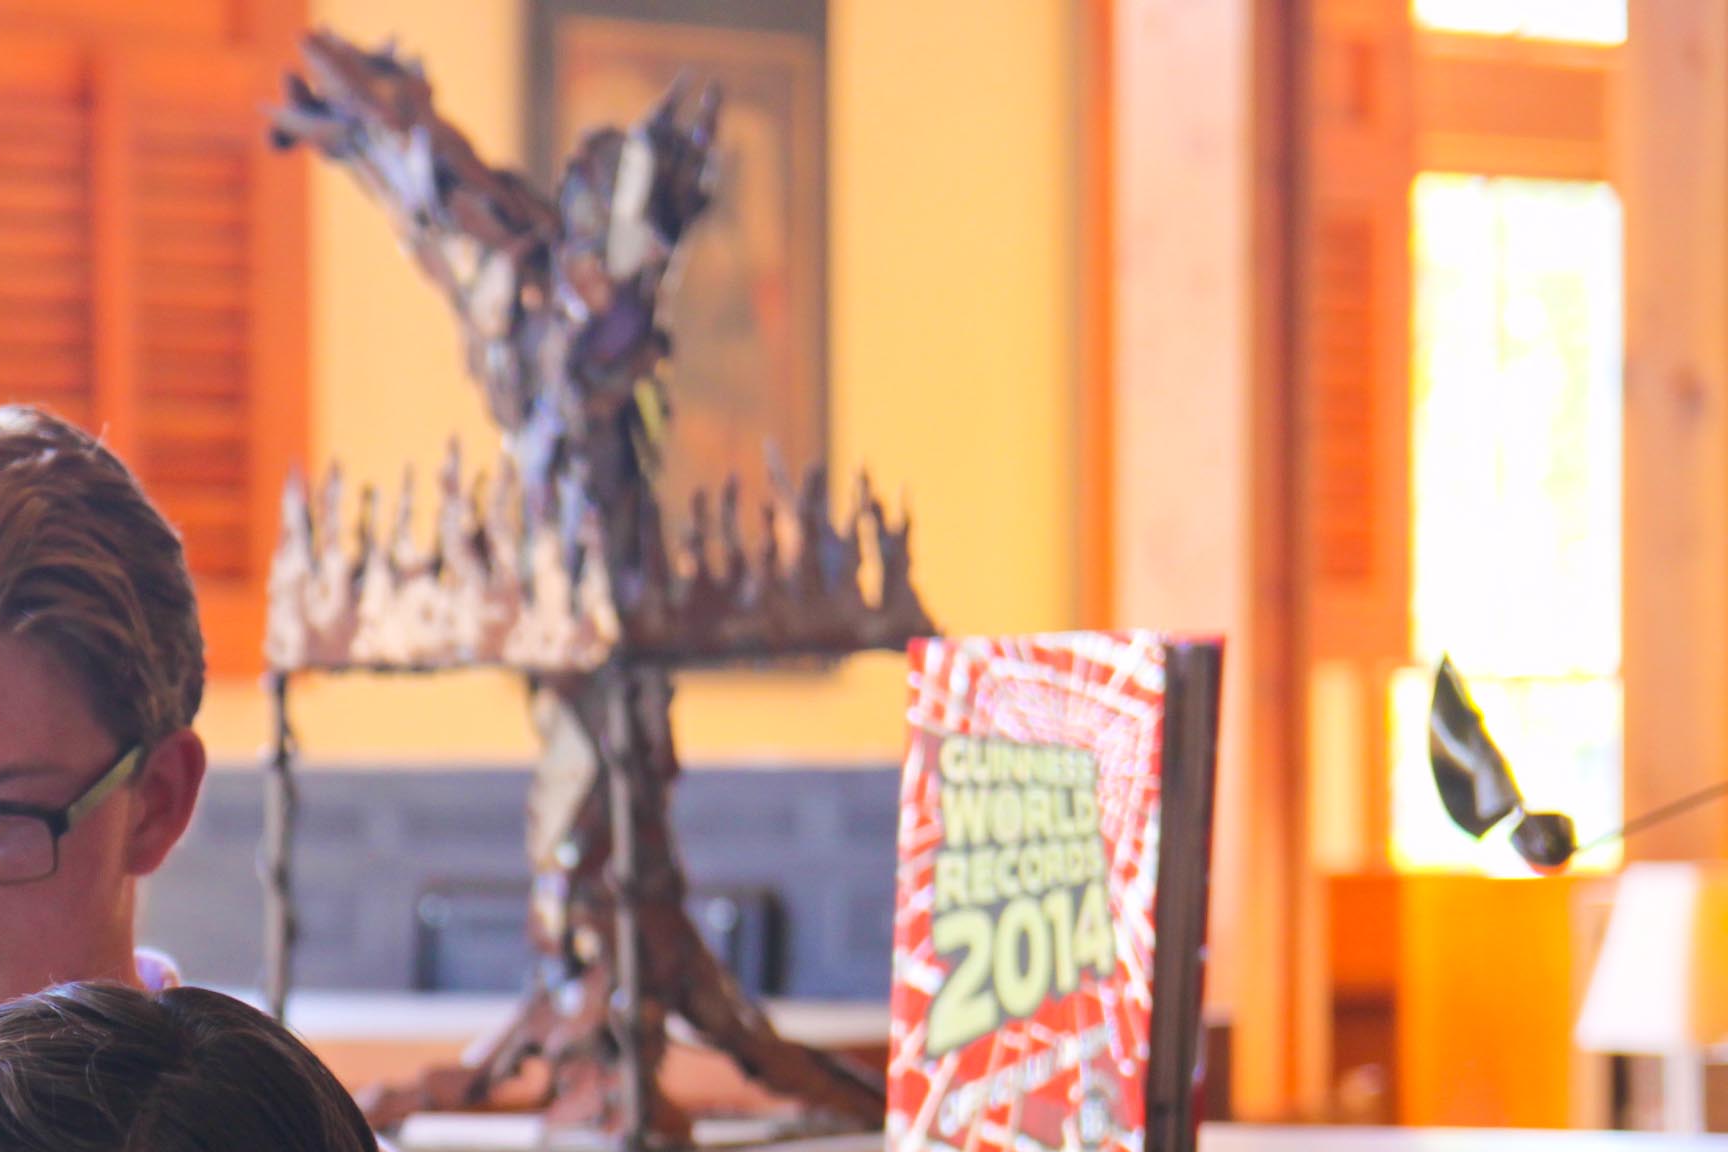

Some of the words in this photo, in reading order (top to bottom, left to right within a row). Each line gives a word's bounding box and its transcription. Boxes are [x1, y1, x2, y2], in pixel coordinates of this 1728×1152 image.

[940, 784, 1100, 850] WORLD
[933, 837, 1106, 912] RECORDS
[925, 880, 1117, 1056] 2014
